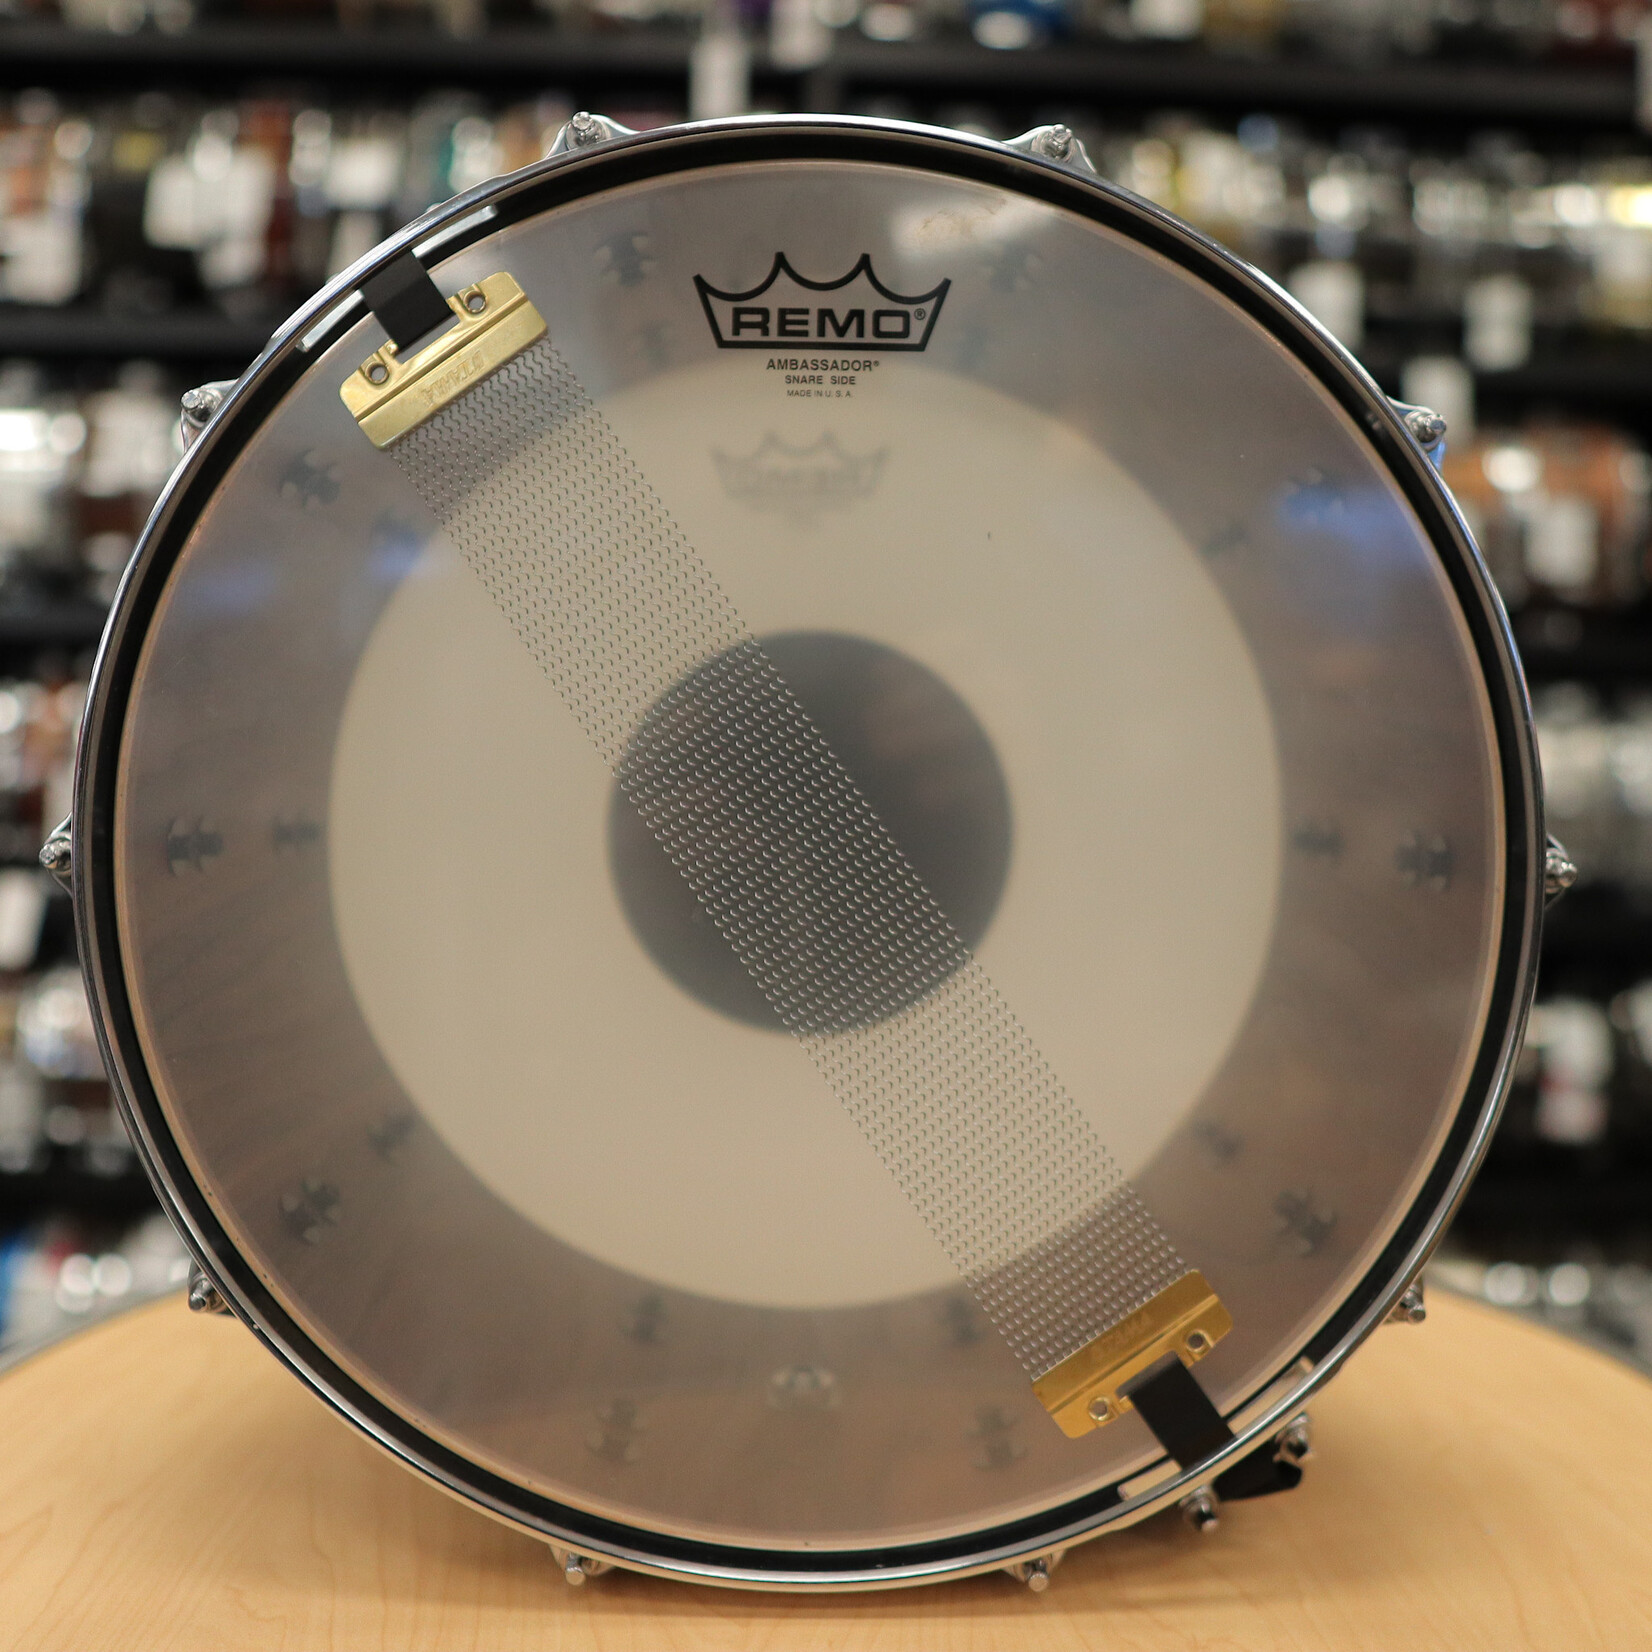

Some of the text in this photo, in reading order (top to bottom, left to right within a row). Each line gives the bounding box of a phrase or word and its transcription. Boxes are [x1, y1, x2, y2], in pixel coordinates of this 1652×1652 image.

[785, 375, 856, 385] SNARE SIDE
[786, 389, 812, 398] MADE
[813, 389, 823, 398] IN
